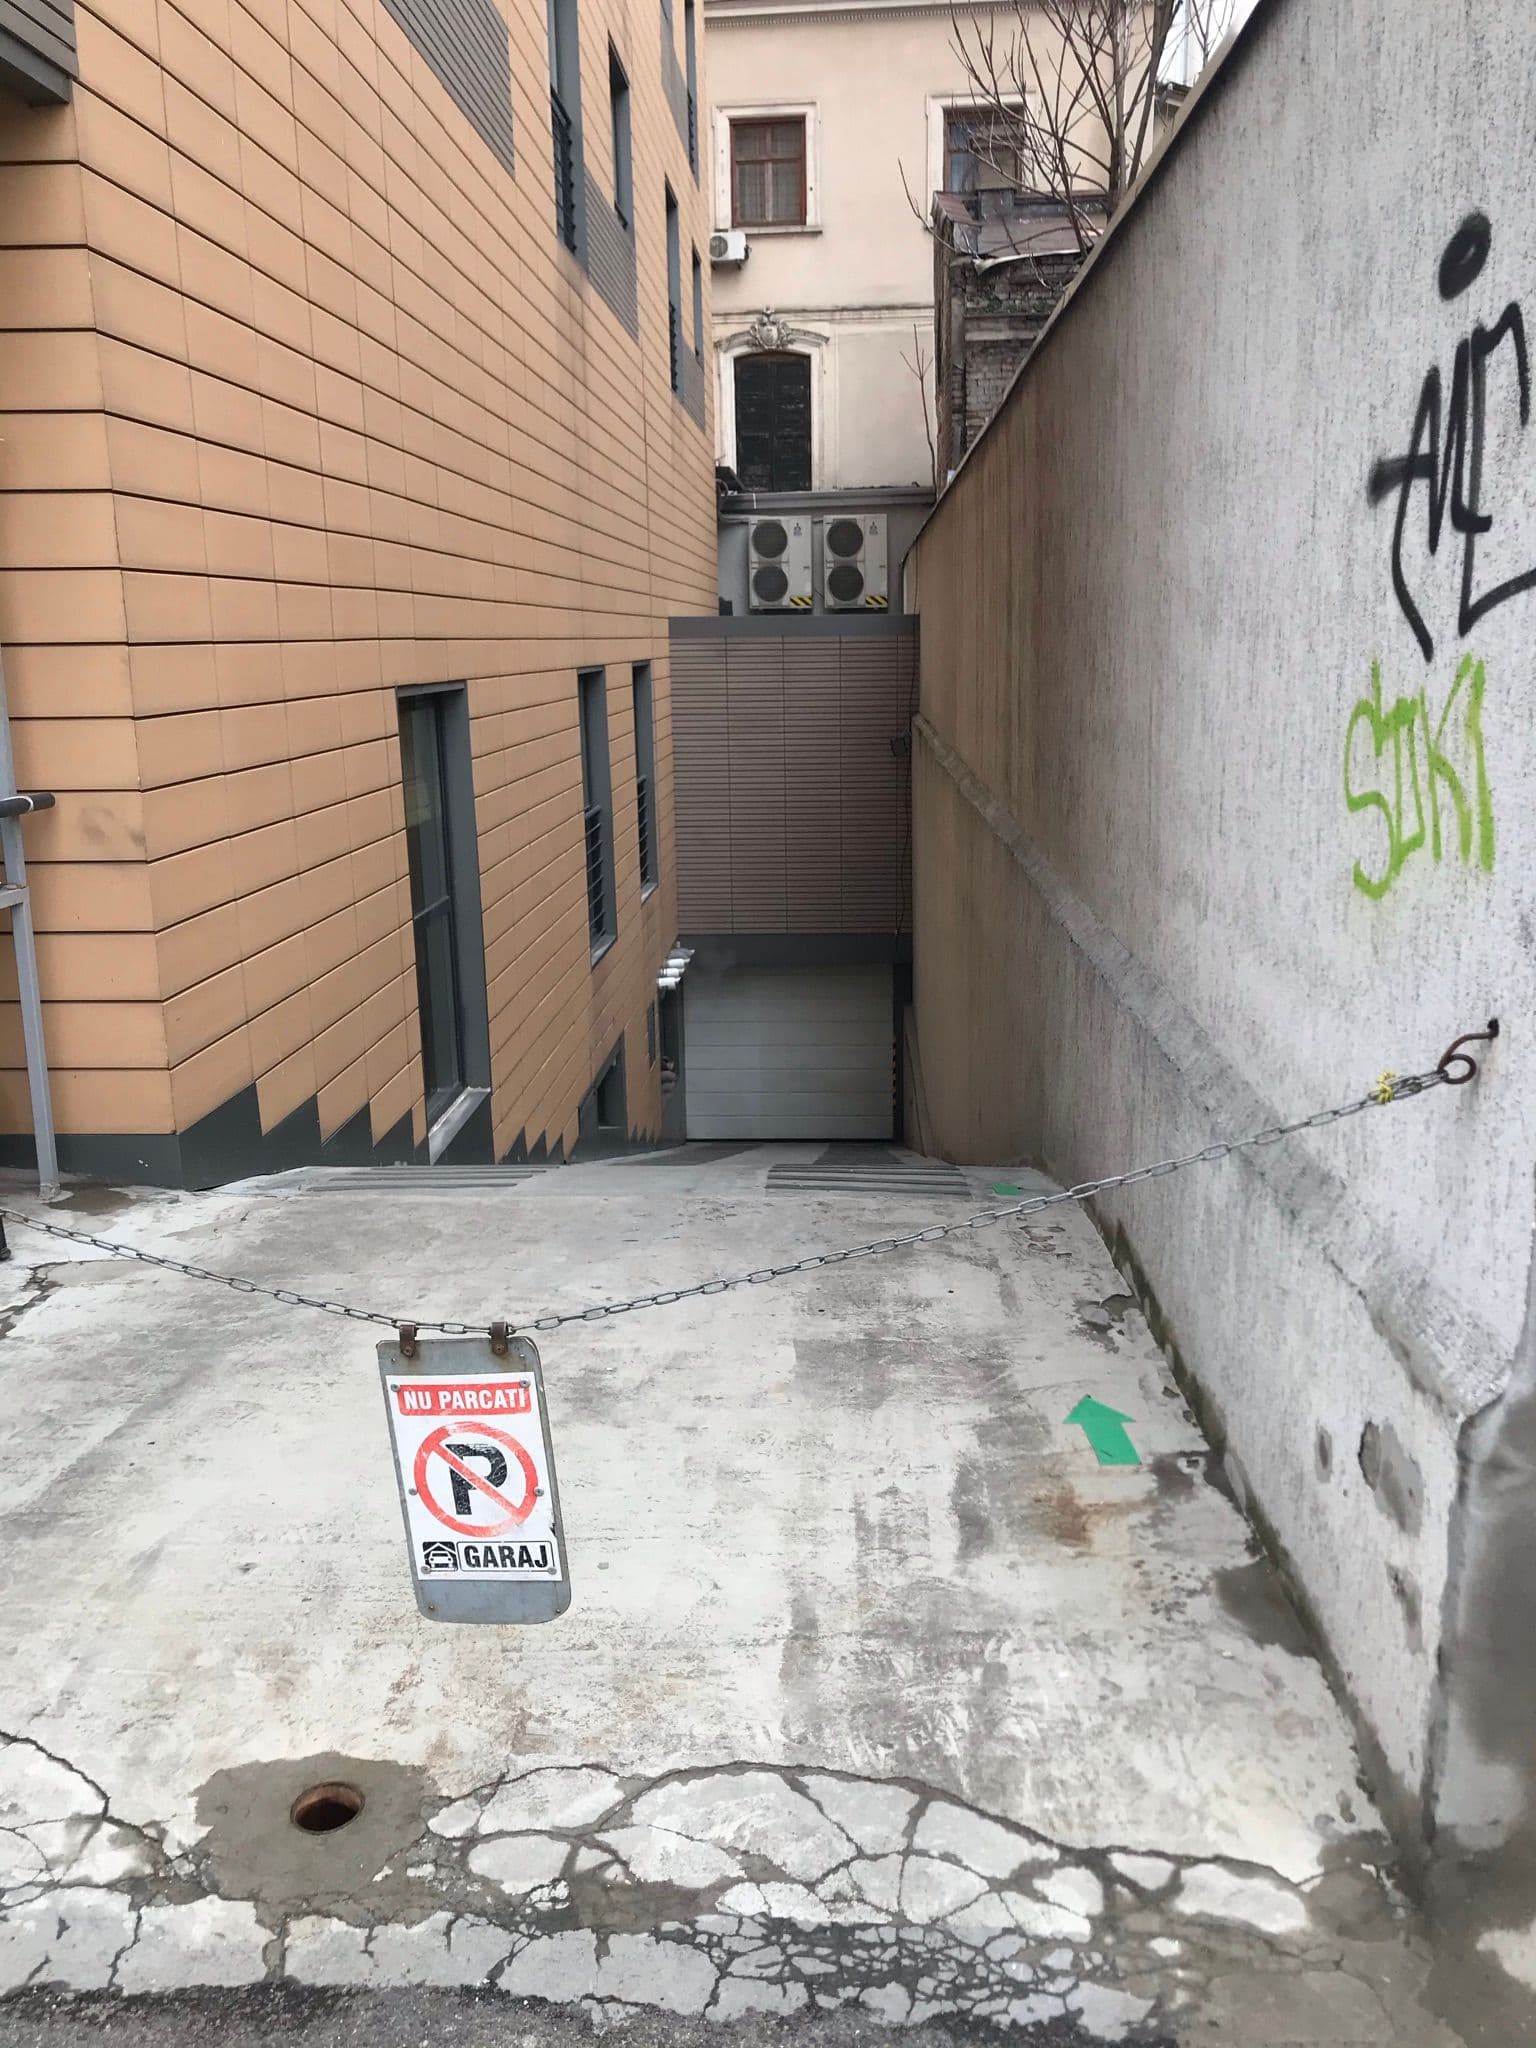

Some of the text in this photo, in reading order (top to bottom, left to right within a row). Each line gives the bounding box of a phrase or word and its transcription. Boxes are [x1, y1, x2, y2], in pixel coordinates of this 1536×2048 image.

[403, 1387, 527, 1411] NU PARCATI
[445, 1443, 508, 1516] P
[463, 1544, 549, 1569] GARAJ
